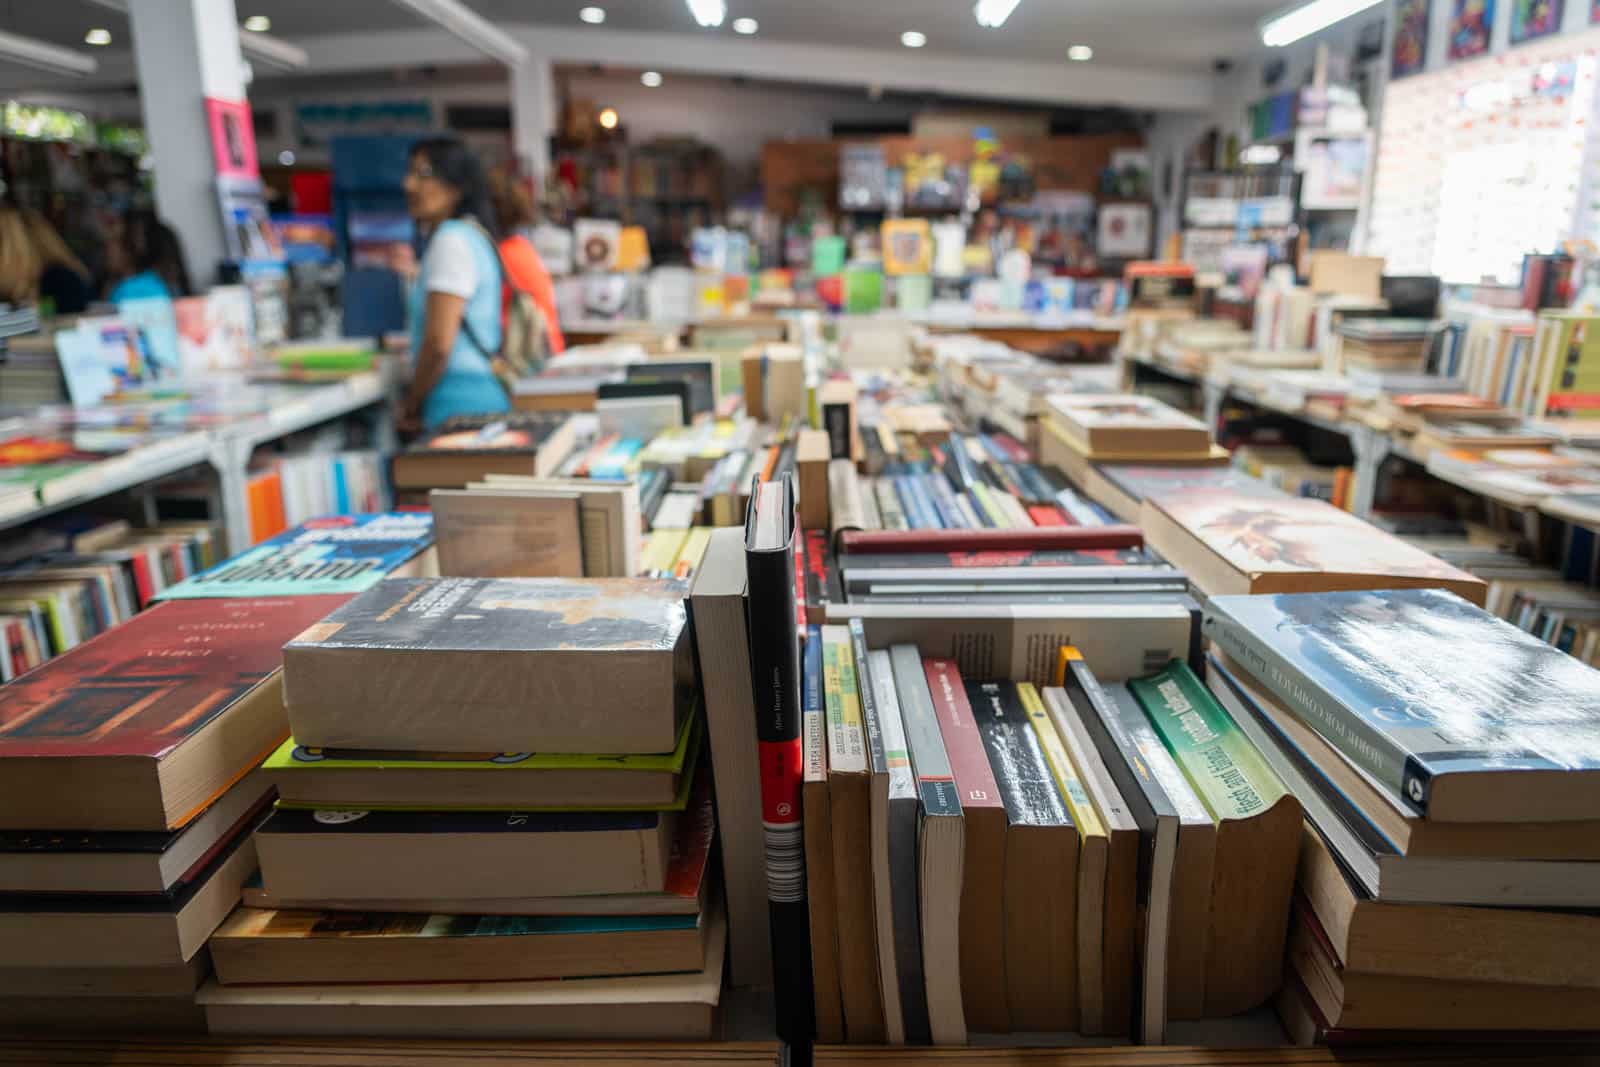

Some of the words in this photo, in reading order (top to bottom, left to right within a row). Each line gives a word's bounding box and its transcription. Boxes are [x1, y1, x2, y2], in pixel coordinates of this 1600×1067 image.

[773, 689, 784, 713] Henry
[1271, 667, 1328, 723] COMPLACER
[1326, 715, 1349, 741] POR
[1201, 745, 1233, 778] blood
[1348, 729, 1385, 769] MORIR
[1218, 767, 1247, 790] and
[1229, 786, 1265, 815] flesh
